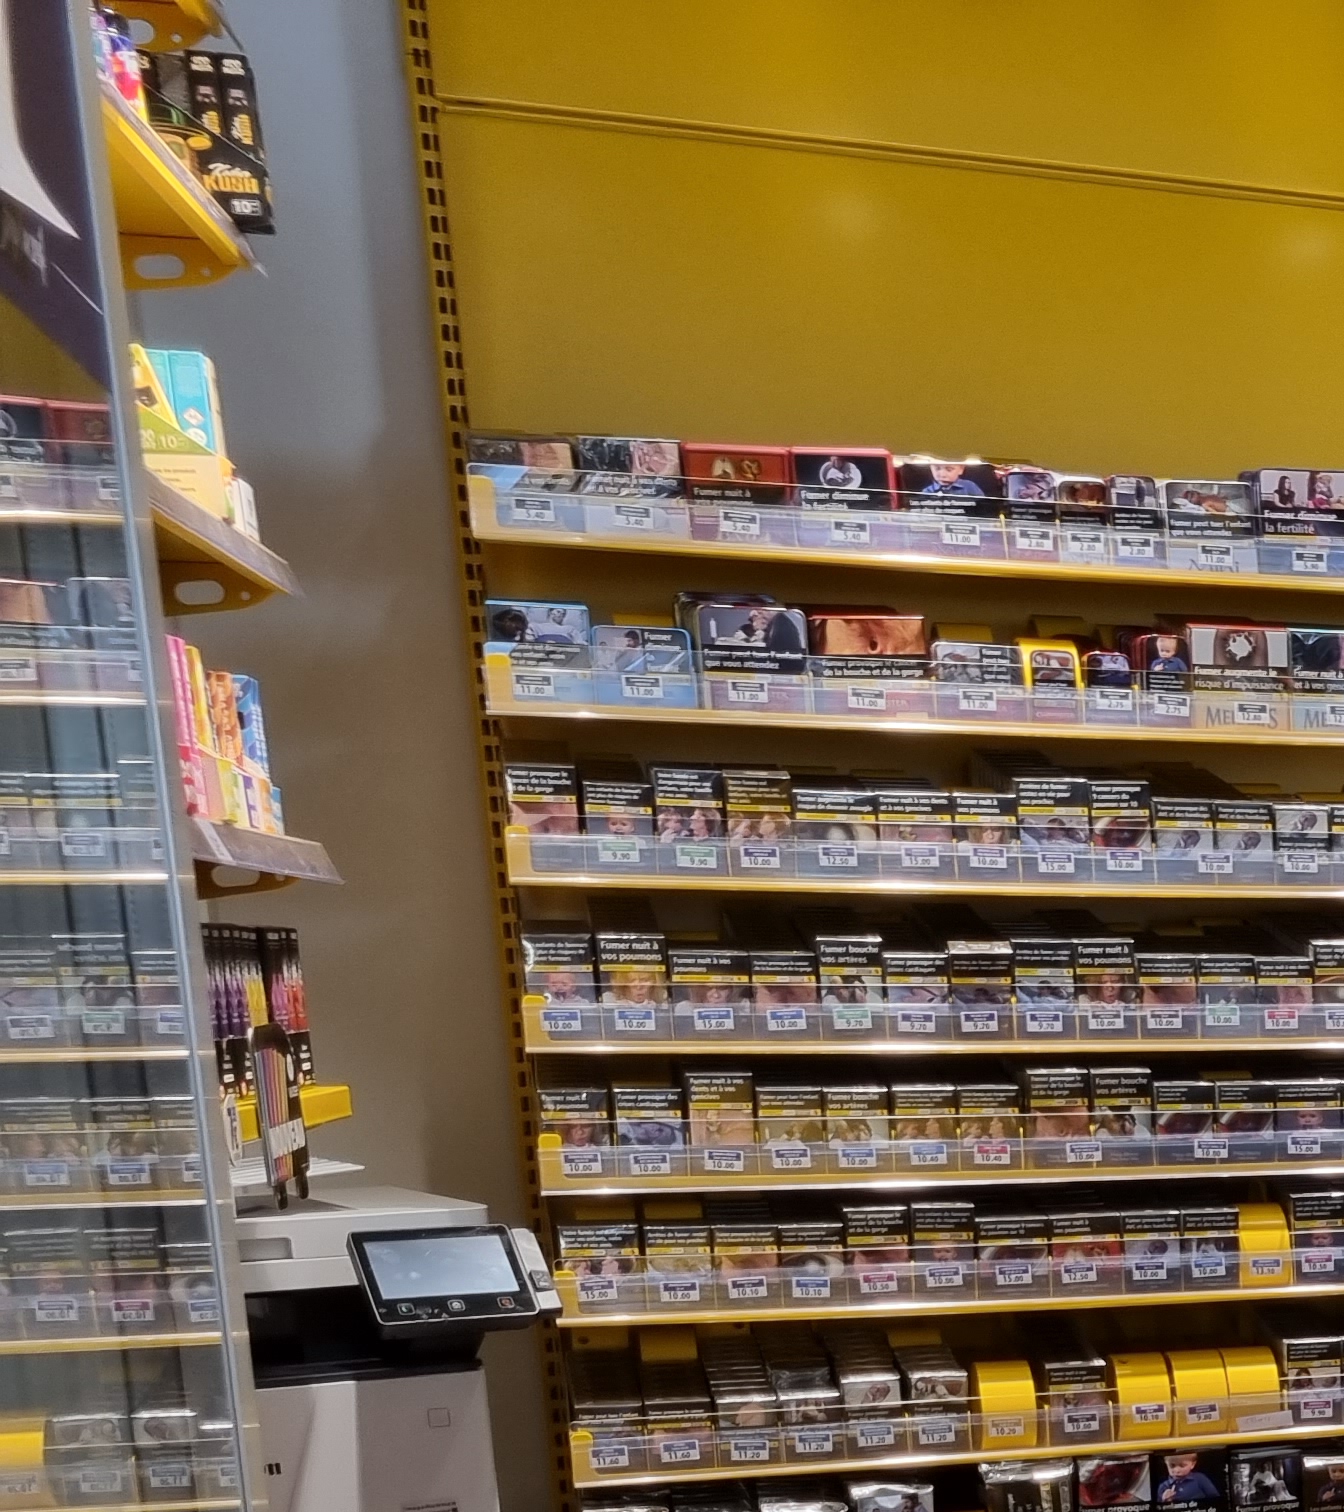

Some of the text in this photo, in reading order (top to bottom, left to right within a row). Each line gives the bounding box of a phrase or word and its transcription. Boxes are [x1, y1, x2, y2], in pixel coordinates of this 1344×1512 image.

[203, 174, 259, 194] KUSH
[1264, 521, 1316, 534] la fertilité
[601, 940, 650, 950] Fumer nuit
[820, 944, 879, 955] Fumer bouche
[601, 952, 663, 964] vos poumons
[840, 954, 868, 965] artères
